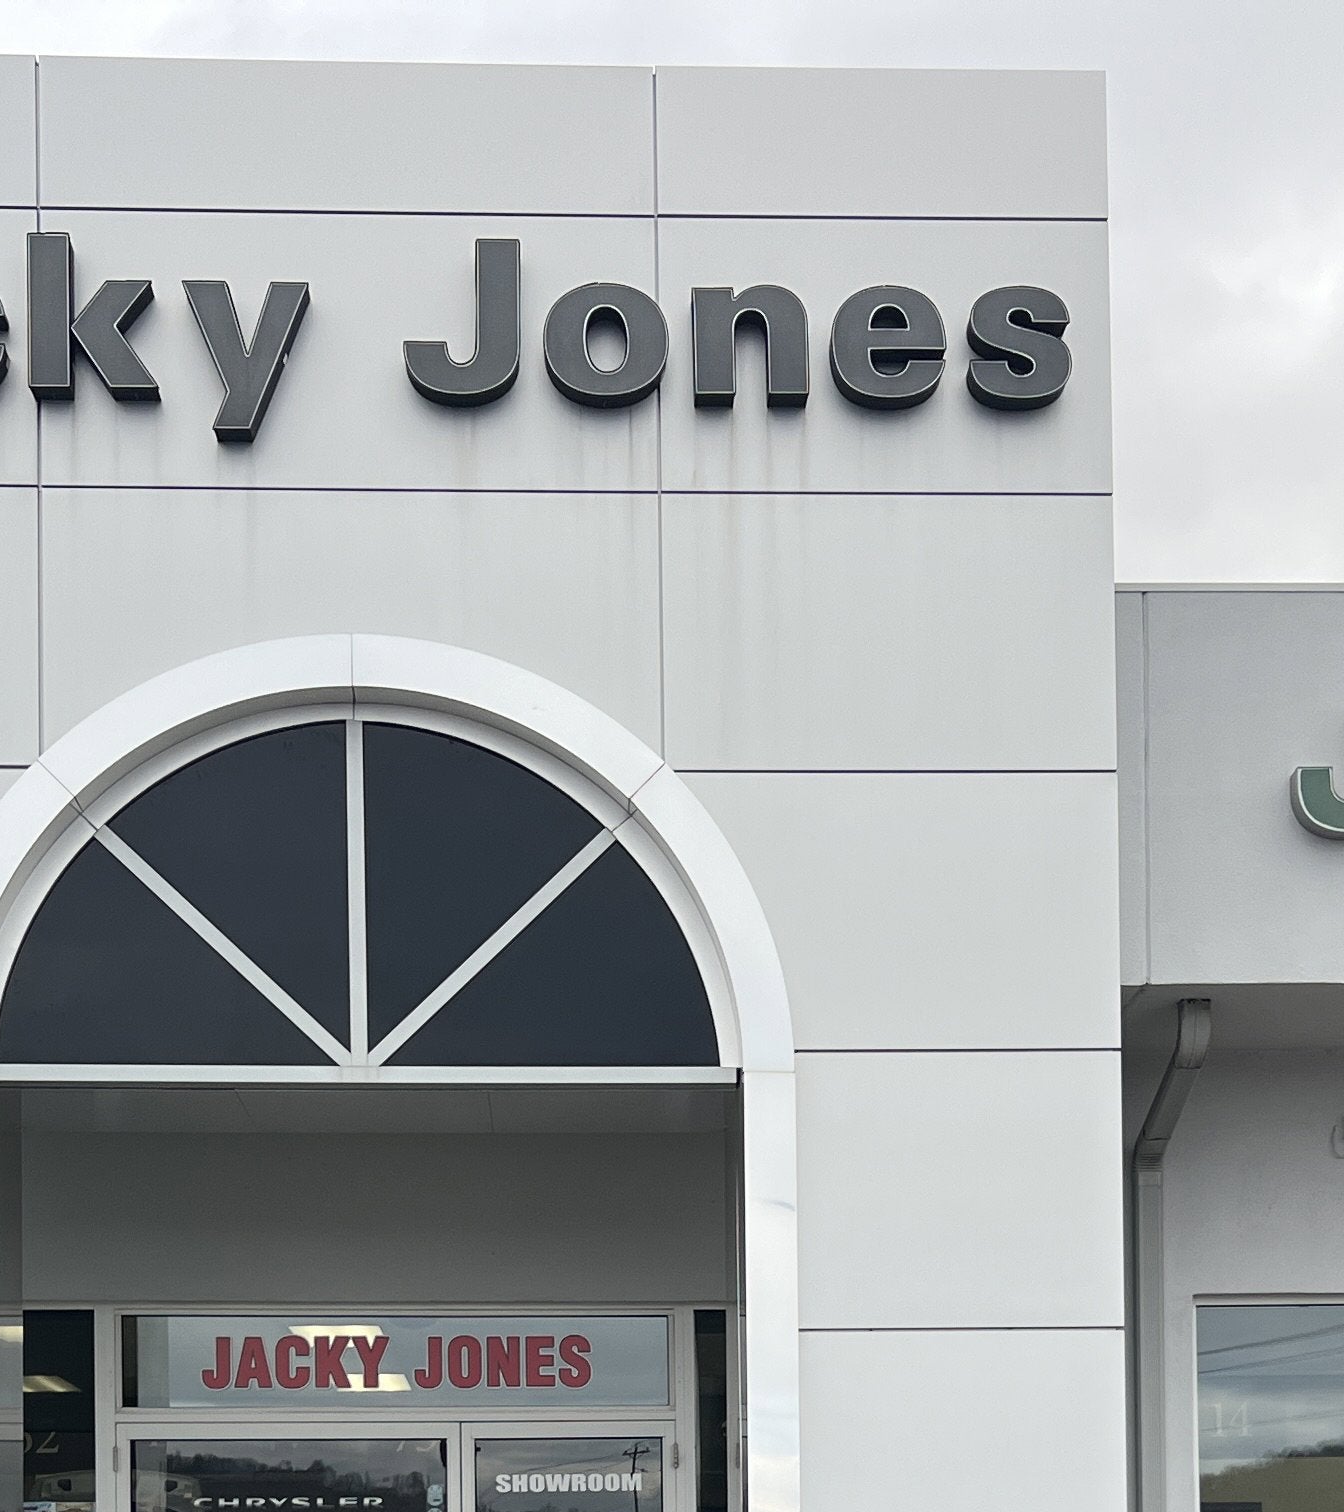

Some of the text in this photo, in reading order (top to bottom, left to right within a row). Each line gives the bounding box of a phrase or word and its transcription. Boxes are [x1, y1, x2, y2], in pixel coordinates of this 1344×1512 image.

[403, 237, 1072, 410] Jones
[201, 1334, 593, 1391] JACKY JONES
[495, 1472, 643, 1493] SHOWROOM
[193, 1496, 385, 1510] CHRYSLER
